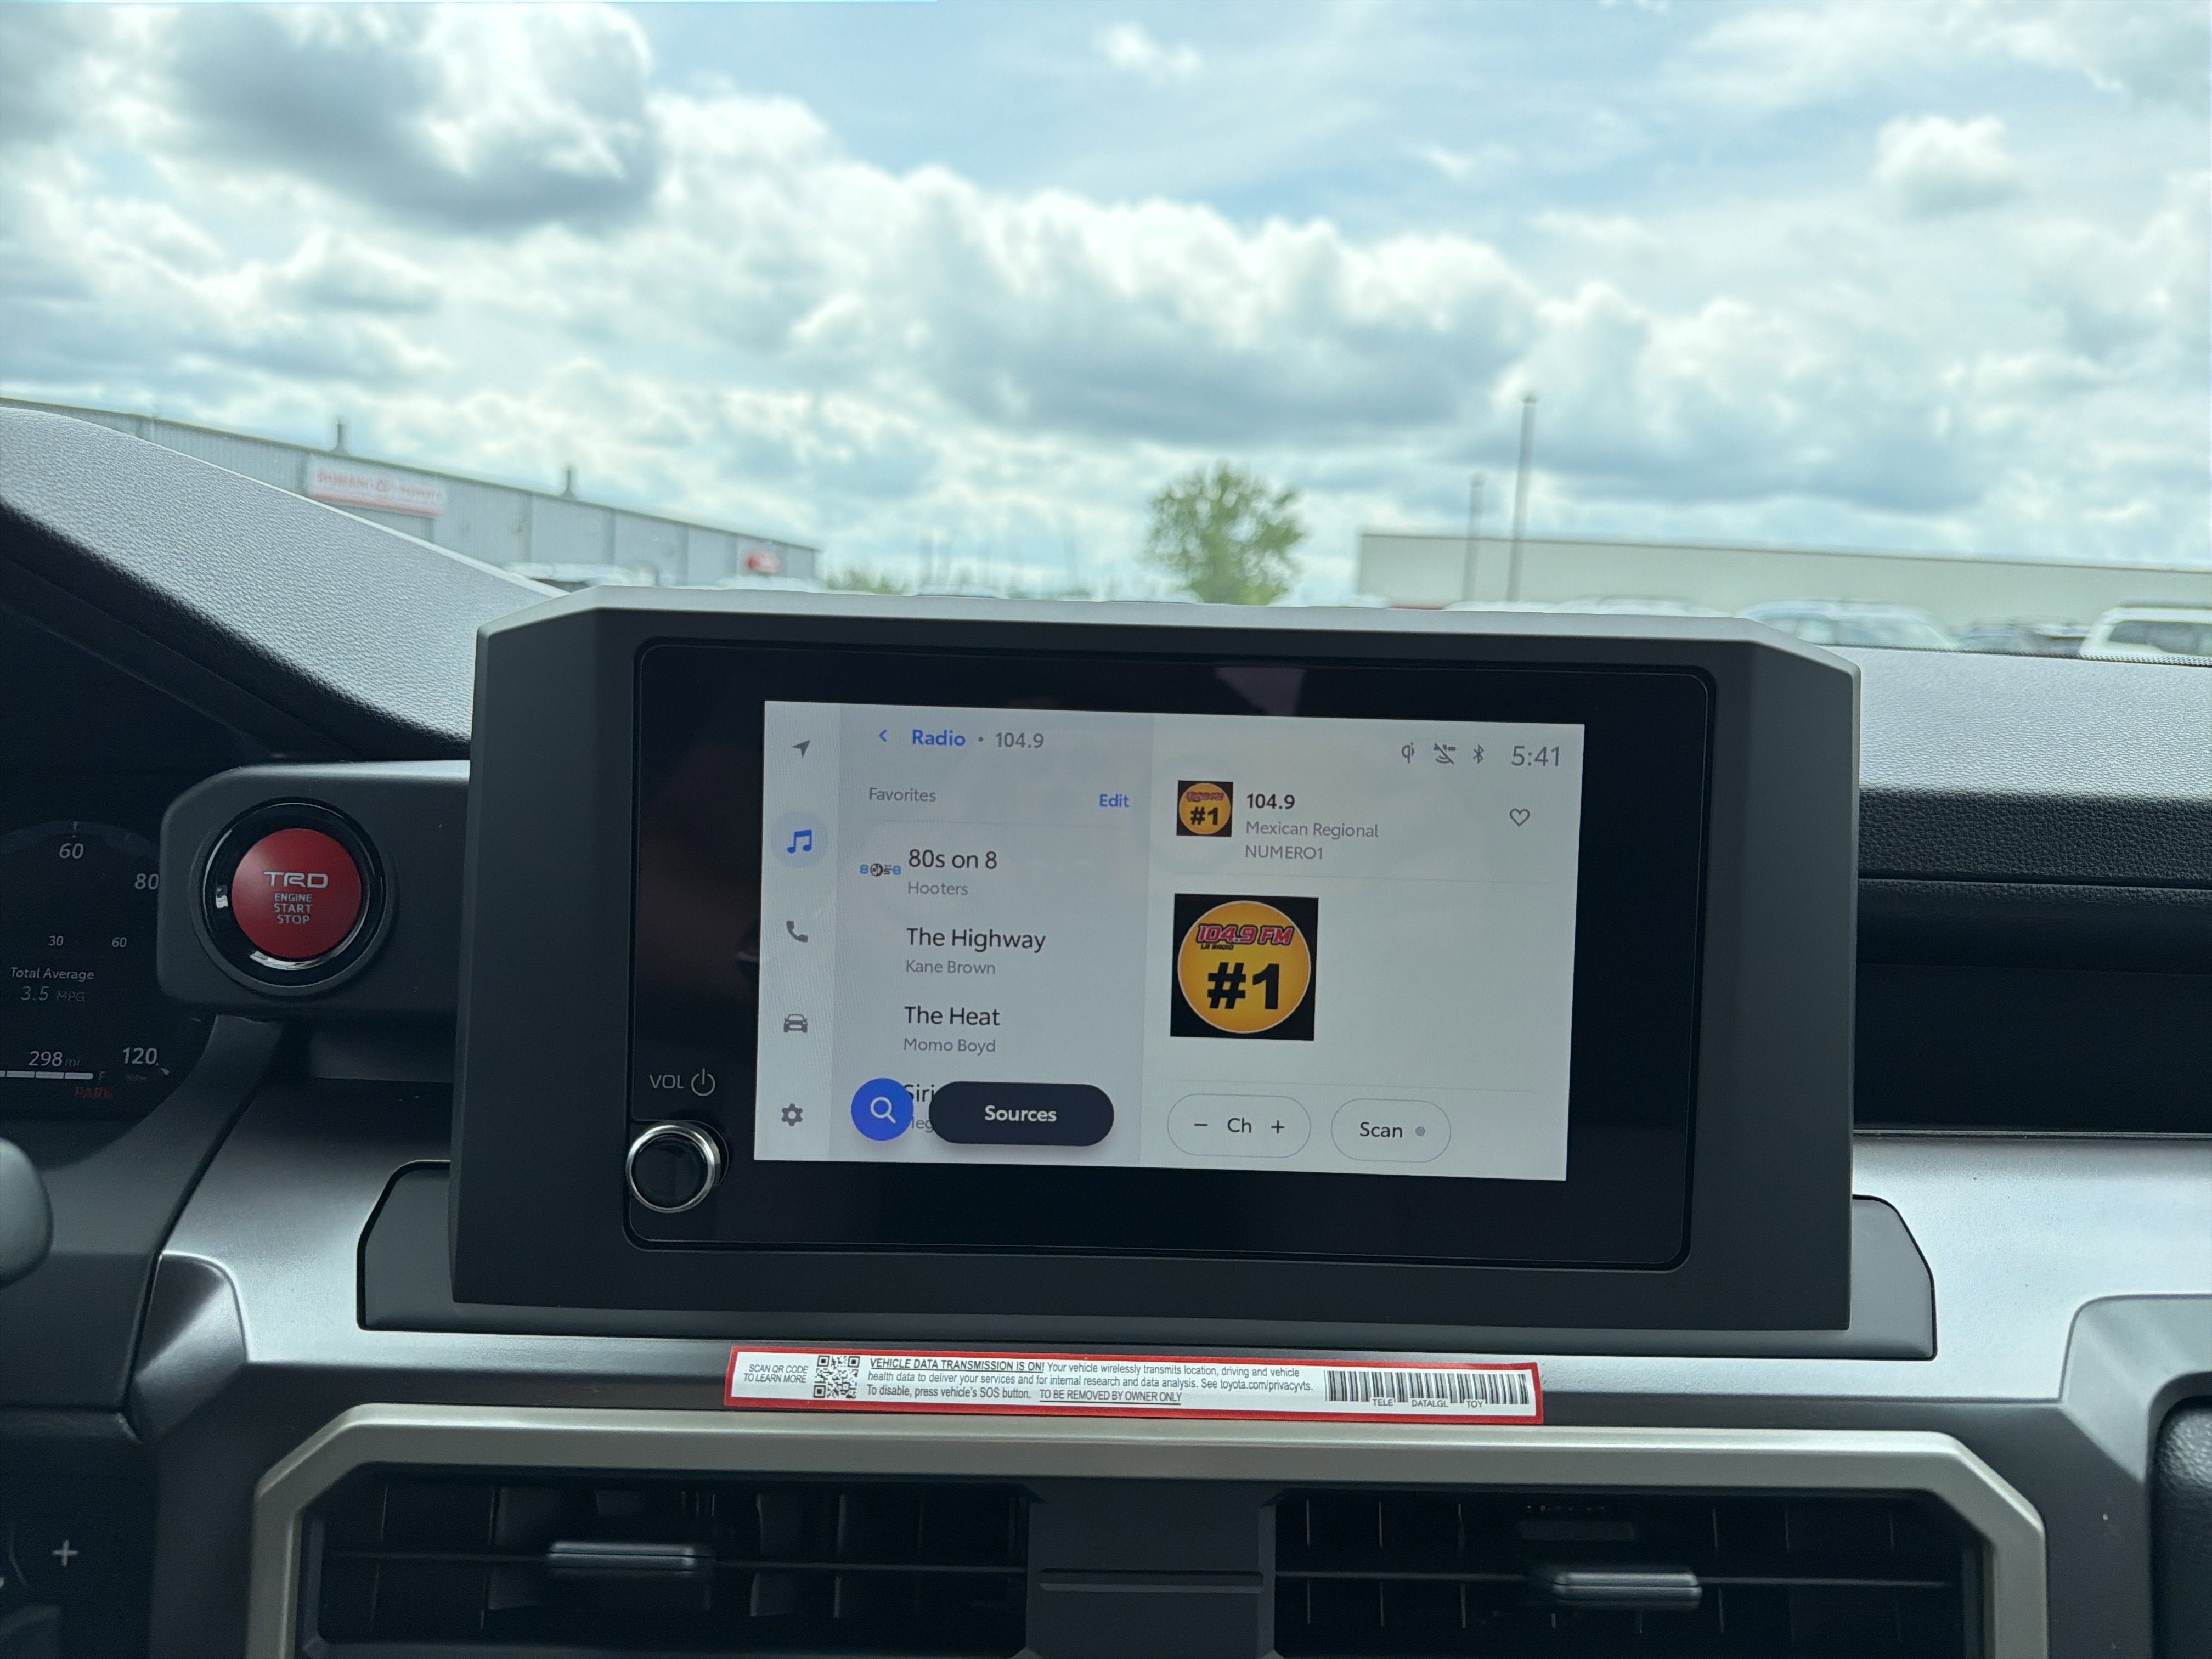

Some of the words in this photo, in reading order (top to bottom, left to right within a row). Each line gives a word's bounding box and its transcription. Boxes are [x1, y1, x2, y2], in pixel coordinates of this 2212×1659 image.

[911, 729, 966, 747] Radio
[995, 732, 1045, 749] 104.9
[1511, 744, 1561, 767] 5:41
[868, 787, 937, 803] Favorites
[1099, 793, 1130, 808] Edit
[1246, 793, 1296, 810] 104.9
[1189, 806, 1218, 826] #1
[1246, 820, 1308, 836] Mexican
[1312, 822, 1379, 840] Regional
[59, 843, 84, 859] 60
[908, 849, 946, 868] 80s
[951, 853, 979, 869] on
[985, 850, 998, 870] 8
[1245, 844, 1324, 860] NUMERO1
[134, 873, 160, 890] 80
[263, 871, 329, 889] TRD
[907, 881, 969, 896] Hooters
[274, 893, 313, 902] ENGINE
[274, 903, 313, 913] START
[276, 914, 311, 924] STOP
[48, 935, 64, 947] 30
[111, 936, 127, 948] 60
[906, 927, 945, 946] The
[951, 928, 1046, 953] Highway
[1196, 923, 1258, 944] 104.9
[1258, 925, 1295, 946] FM
[10, 967, 41, 979] Total
[43, 968, 95, 982] Average
[906, 959, 944, 974] Kane
[947, 960, 996, 975] Brown
[20, 985, 49, 1001] 3.5
[1206, 961, 1280, 1010] #1
[904, 1006, 944, 1025] The
[949, 1006, 1001, 1026] Heat
[903, 1037, 954, 1052] Momo
[957, 1039, 997, 1056] Boyd
[28, 1050, 63, 1067] 298
[122, 1047, 158, 1065] 120
[649, 1074, 684, 1089] VOL
[984, 1104, 1057, 1122] Sources
[1227, 1118, 1252, 1134] Ch
[1359, 1121, 1403, 1138] Scan
[748, 1364, 771, 1373] SCAN
[772, 1364, 785, 1373] QR
[786, 1365, 809, 1374] CODE
[870, 1358, 911, 1368] VEHICLE
[913, 1359, 939, 1369] DATA
[941, 1359, 1014, 1371] TRANSMISSION
[1017, 1361, 1025, 1370] IS
[1028, 1361, 1045, 1371] ON!
[1047, 1362, 1067, 1372] Your
[1069, 1362, 1098, 1373] vehicle
[1101, 1363, 1141, 1375] wirelessly
[1144, 1364, 1182, 1375] transmits
[1184, 1365, 1219, 1377] location,
[1221, 1366, 1249, 1378] driving
[1252, 1367, 1267, 1376] and
[1270, 1368, 1300, 1378] vehicle
[744, 1373, 754, 1382] TO
[755, 1373, 781, 1383] LEARN
[783, 1374, 807, 1383] MORE
[867, 1370, 894, 1381] health
[896, 1372, 915, 1382] data
[918, 1373, 926, 1382] to
[929, 1373, 958, 1383] deliver
[960, 1375, 979, 1386] your
[980, 1375, 1015, 1384] services
[1018, 1375, 1034, 1384] and
[1036, 1375, 1048, 1385] for
[1050, 1375, 1081, 1386] internal
[1084, 1376, 1120, 1386] research
[1122, 1376, 1138, 1387] and
[1141, 1377, 1159, 1387] data
[1161, 1378, 1199, 1390] analysis.
[1201, 1378, 1218, 1389] See
[1220, 1379, 1313, 1393] toyota.com/privacyvts.
[867, 1384, 877, 1395] To
[879, 1385, 912, 1397] disable,
[915, 1387, 938, 1398] press
[940, 1386, 977, 1397] vehicle's
[979, 1386, 1000, 1398] SOS
[1002, 1387, 1031, 1399] button.
[1040, 1389, 1052, 1399] TO
[1053, 1389, 1065, 1400] BE
[1067, 1390, 1110, 1400] REMOVED
[1111, 1391, 1124, 1401] BY
[1125, 1391, 1158, 1401] OWNER
[1159, 1391, 1183, 1402] ONLY
[1372, 1398, 1394, 1407] TELE
[1412, 1399, 1449, 1408] DATALGL
[1465, 1400, 1483, 1408] TOY
